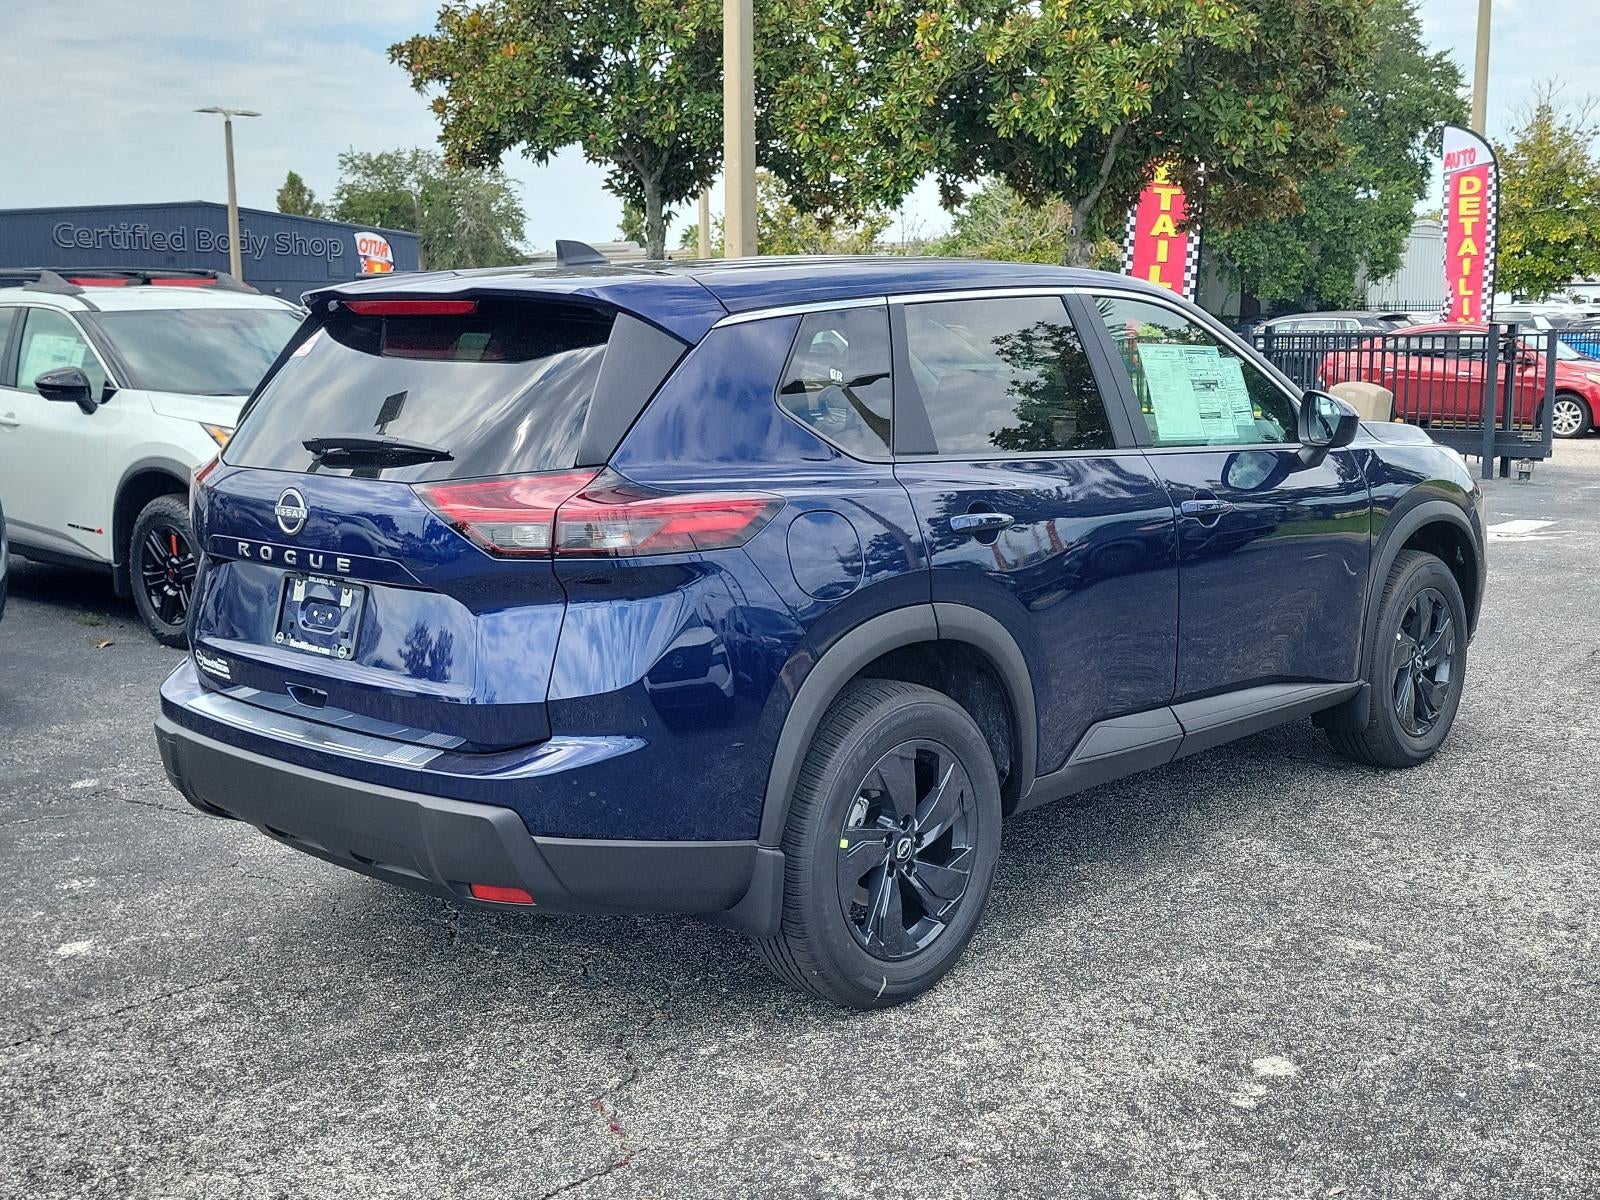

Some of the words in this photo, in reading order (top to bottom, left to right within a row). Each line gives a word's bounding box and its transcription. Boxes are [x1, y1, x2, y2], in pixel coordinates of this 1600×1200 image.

[1443, 147, 1476, 170] AUTO
[52, 222, 188, 252] Certified
[195, 228, 269, 260] Body
[274, 231, 344, 263] Shop
[1457, 175, 1483, 324] DETAILI
[275, 506, 307, 519] NISSAN
[237, 541, 351, 573] ROGUE
